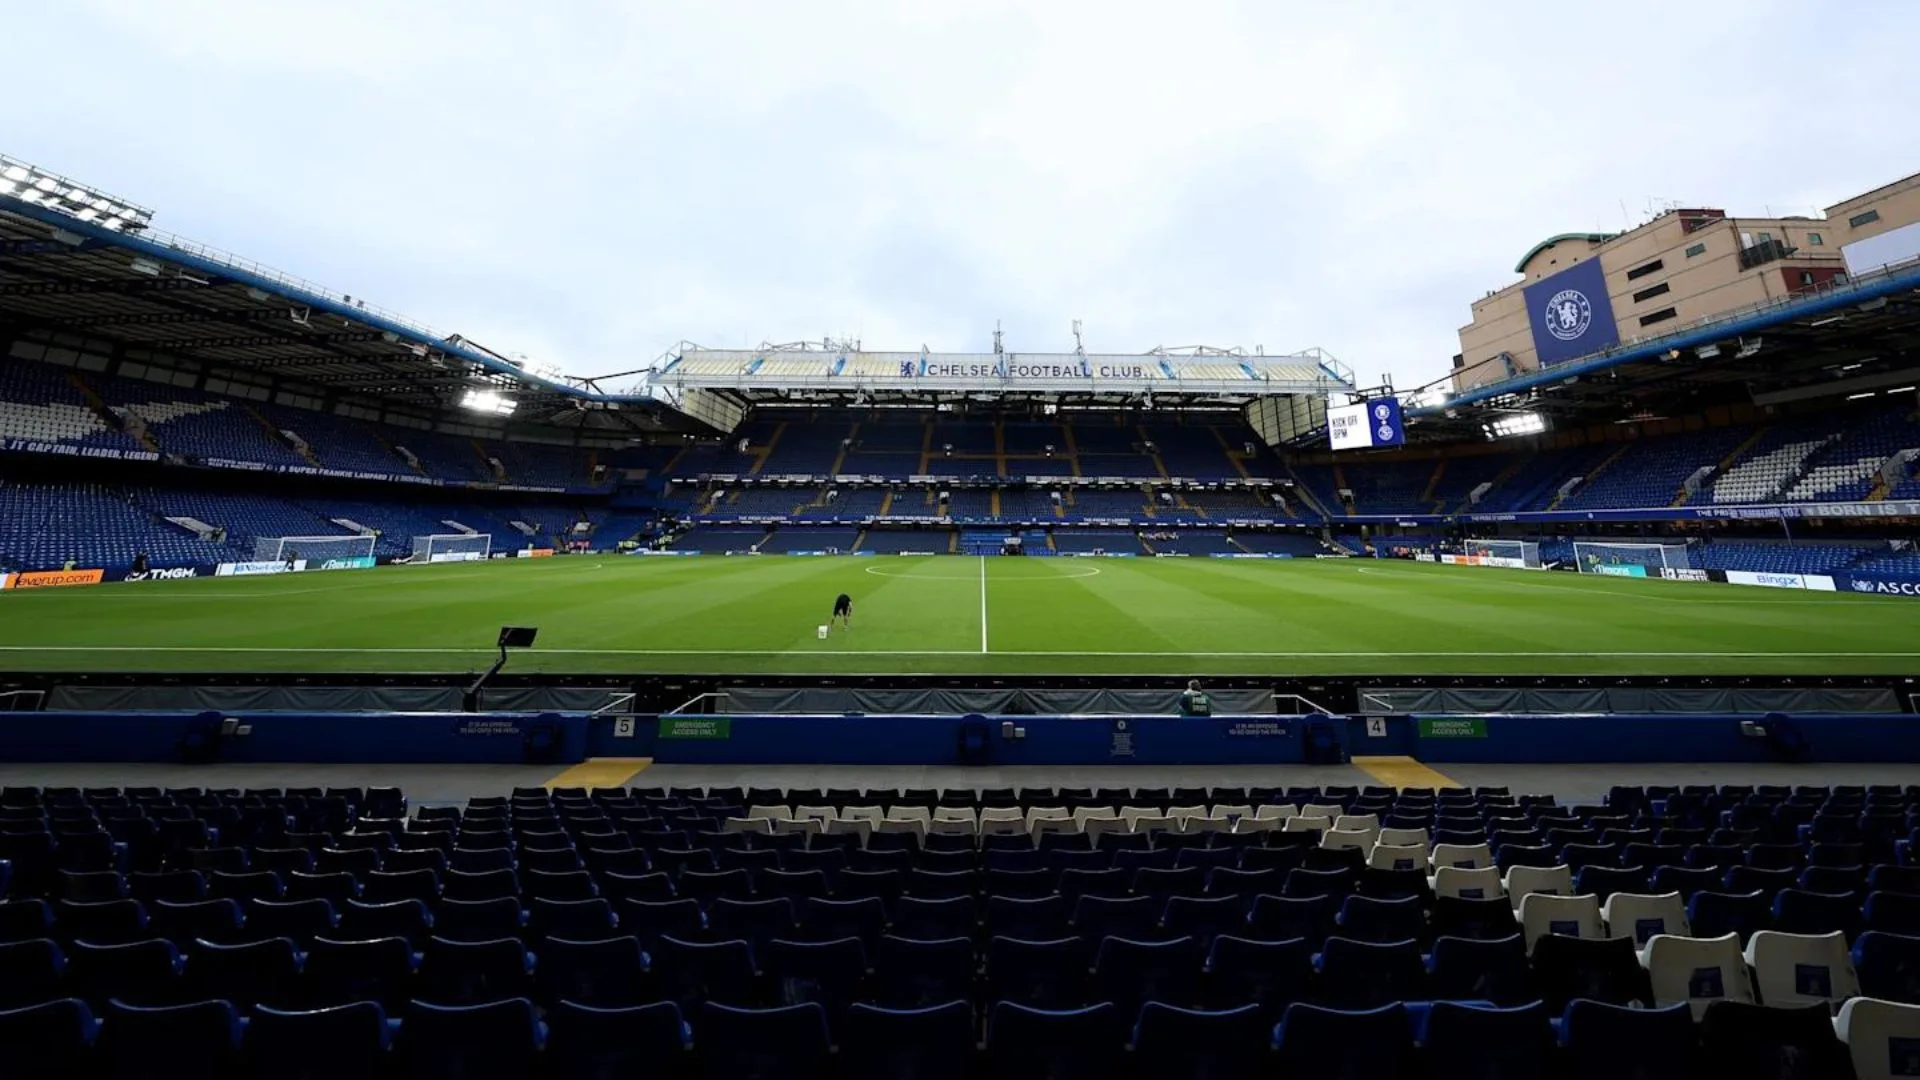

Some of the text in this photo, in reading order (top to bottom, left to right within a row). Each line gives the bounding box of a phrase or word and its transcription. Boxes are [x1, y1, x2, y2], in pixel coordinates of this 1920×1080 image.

[928, 364, 1142, 378] CHELSEA FOOTBALL CLUB
[1332, 416, 1347, 428] KICK
[9, 440, 26, 450] JT
[27, 441, 79, 456] CAPTAIN,
[81, 446, 122, 459] LEADER,
[124, 450, 159, 461] LEGEND
[288, 465, 317, 475] SUPER
[1818, 503, 1872, 516] BORN
[1878, 503, 1897, 516] IS
[150, 567, 195, 580] TMGM
[619, 720, 629, 733] 5
[1371, 720, 1381, 732] 4
